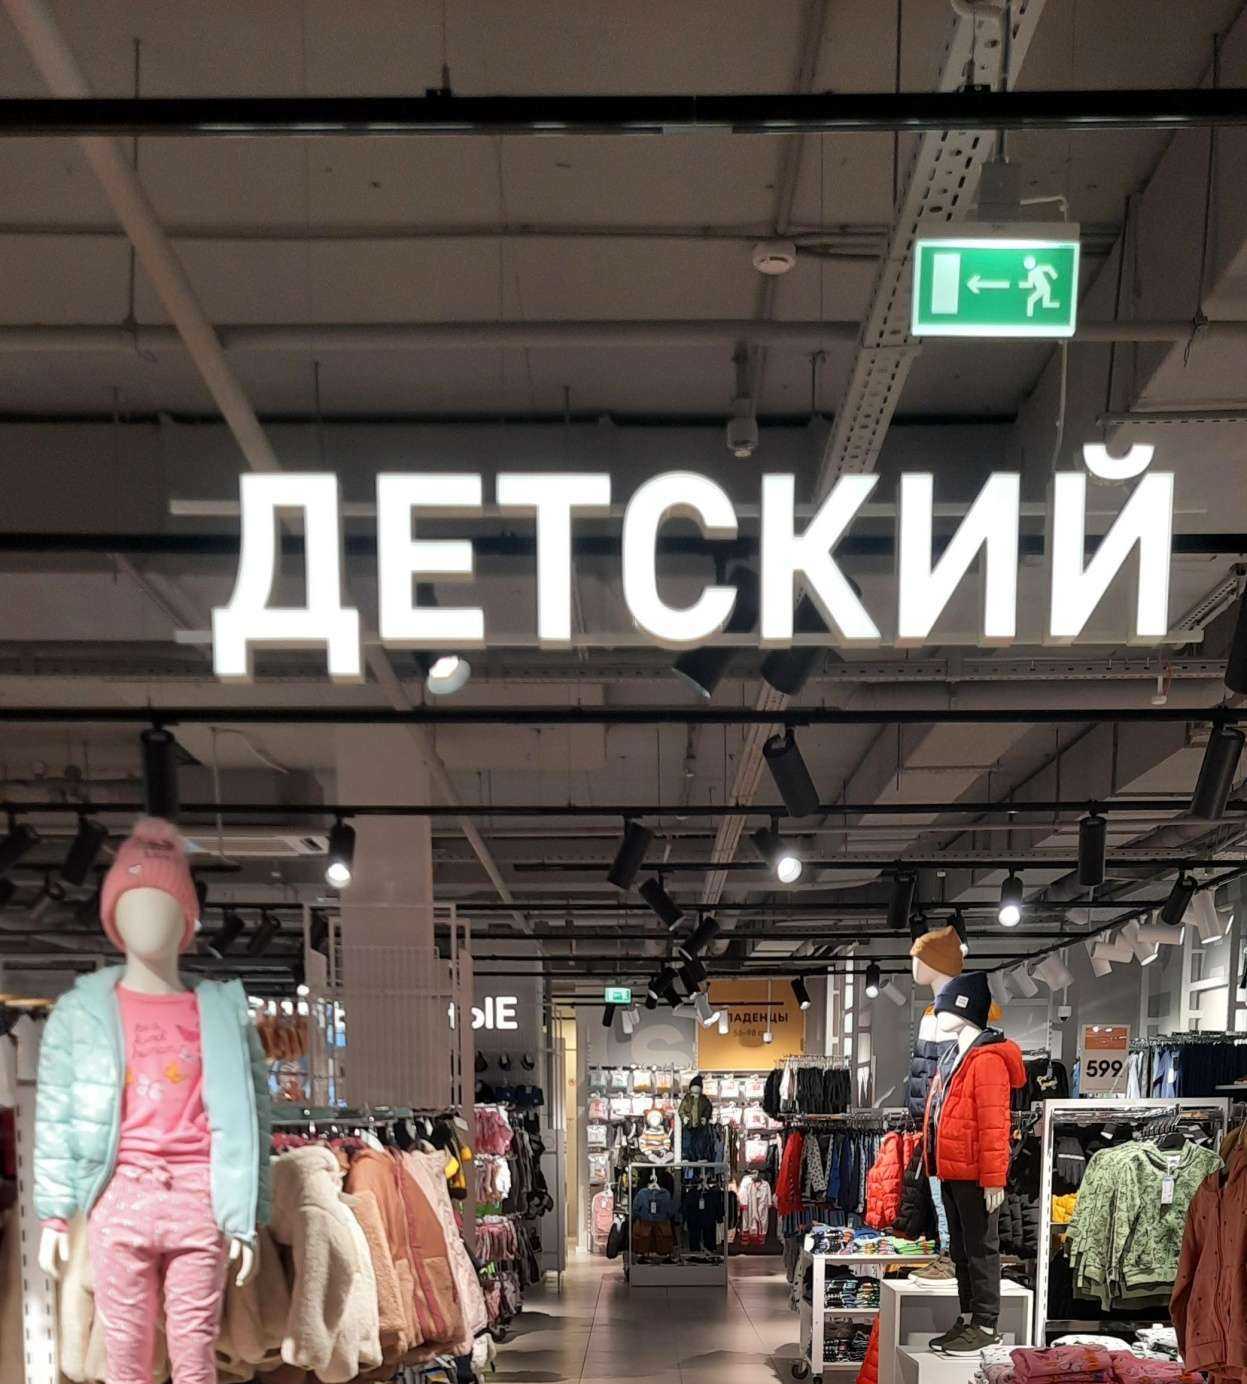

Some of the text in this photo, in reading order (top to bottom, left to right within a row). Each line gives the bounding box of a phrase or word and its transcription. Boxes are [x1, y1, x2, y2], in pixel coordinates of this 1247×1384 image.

[212, 444, 1175, 682] ДЕТСКИЙ
[728, 1012, 788, 1024] ЛАДЕНЦЫ
[1086, 1060, 1123, 1078] 599
